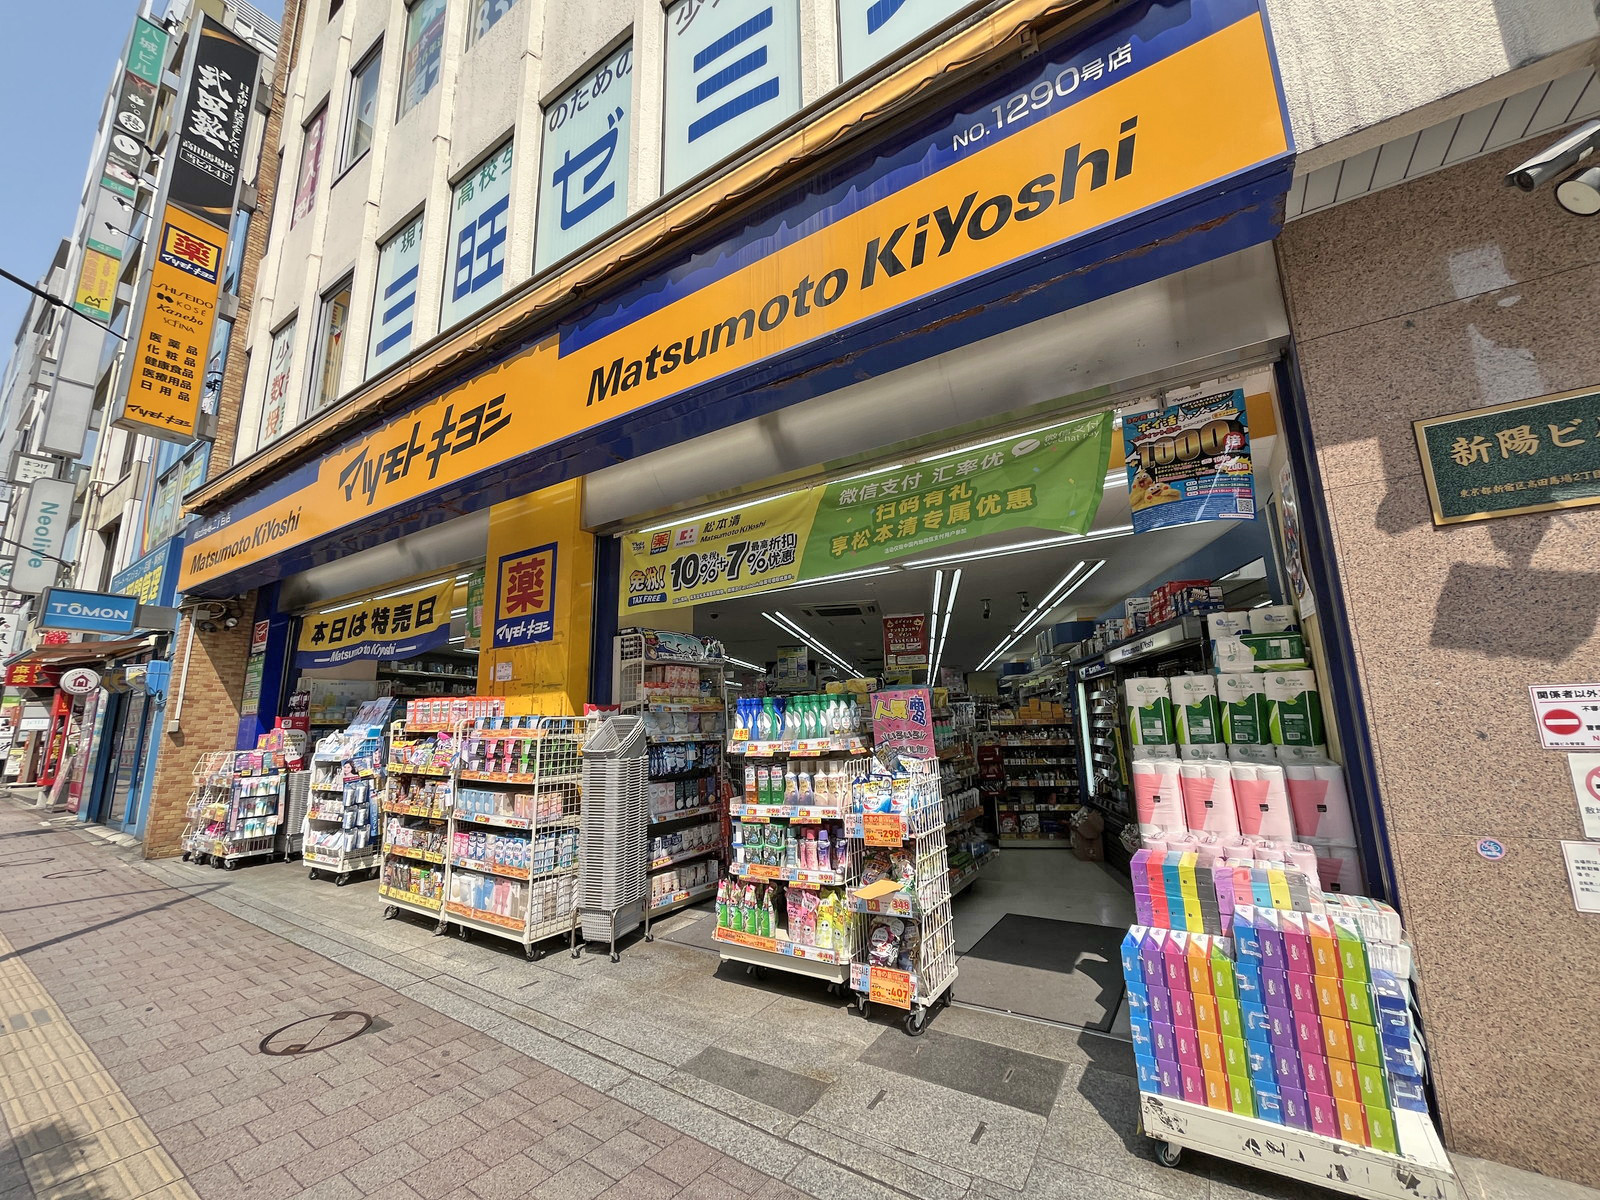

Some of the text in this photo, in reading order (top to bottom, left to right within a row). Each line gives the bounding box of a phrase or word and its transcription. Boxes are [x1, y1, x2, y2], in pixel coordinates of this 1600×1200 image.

[552, 106, 624, 231] ゼ
[173, 232, 212, 268] 薬
[587, 115, 1138, 406] Matsumoto KiYoshi
[162, 253, 216, 281] マツモトキヨシ
[152, 283, 214, 309] SHISEIDO
[156, 304, 204, 326] Kanebo
[150, 331, 198, 356] 医薬品
[144, 356, 194, 378] 健康食品
[147, 344, 196, 368] 化粧品
[140, 380, 190, 402] 日用品
[142, 368, 192, 390] 医療用品
[127, 404, 192, 428] マツモトキヨシ
[338, 392, 513, 506] マツモトキヨシ
[838, 451, 1004, 506] 微信支付 汇率优
[875, 481, 973, 523] 扫码有礼
[702, 514, 741, 533] 松本清
[831, 486, 1033, 556] 享松本清专属优惠
[28, 501, 60, 569] Neolive
[190, 534, 250, 576] Matsumoto
[250, 506, 302, 550] KiYoshi
[700, 526, 740, 543] Matsumoto
[768, 550, 796, 570] 优惠
[506, 557, 546, 614] 薬
[632, 594, 662, 604] TAX FREE
[311, 595, 437, 645] 本日は特売日
[496, 619, 550, 642] マツモトキヨシ
[1536, 690, 1600, 700] 関係者以外
[909, 696, 927, 726] 商品
[883, 830, 900, 838] 298
[892, 900, 910, 910] 348
[891, 989, 908, 998] 407
